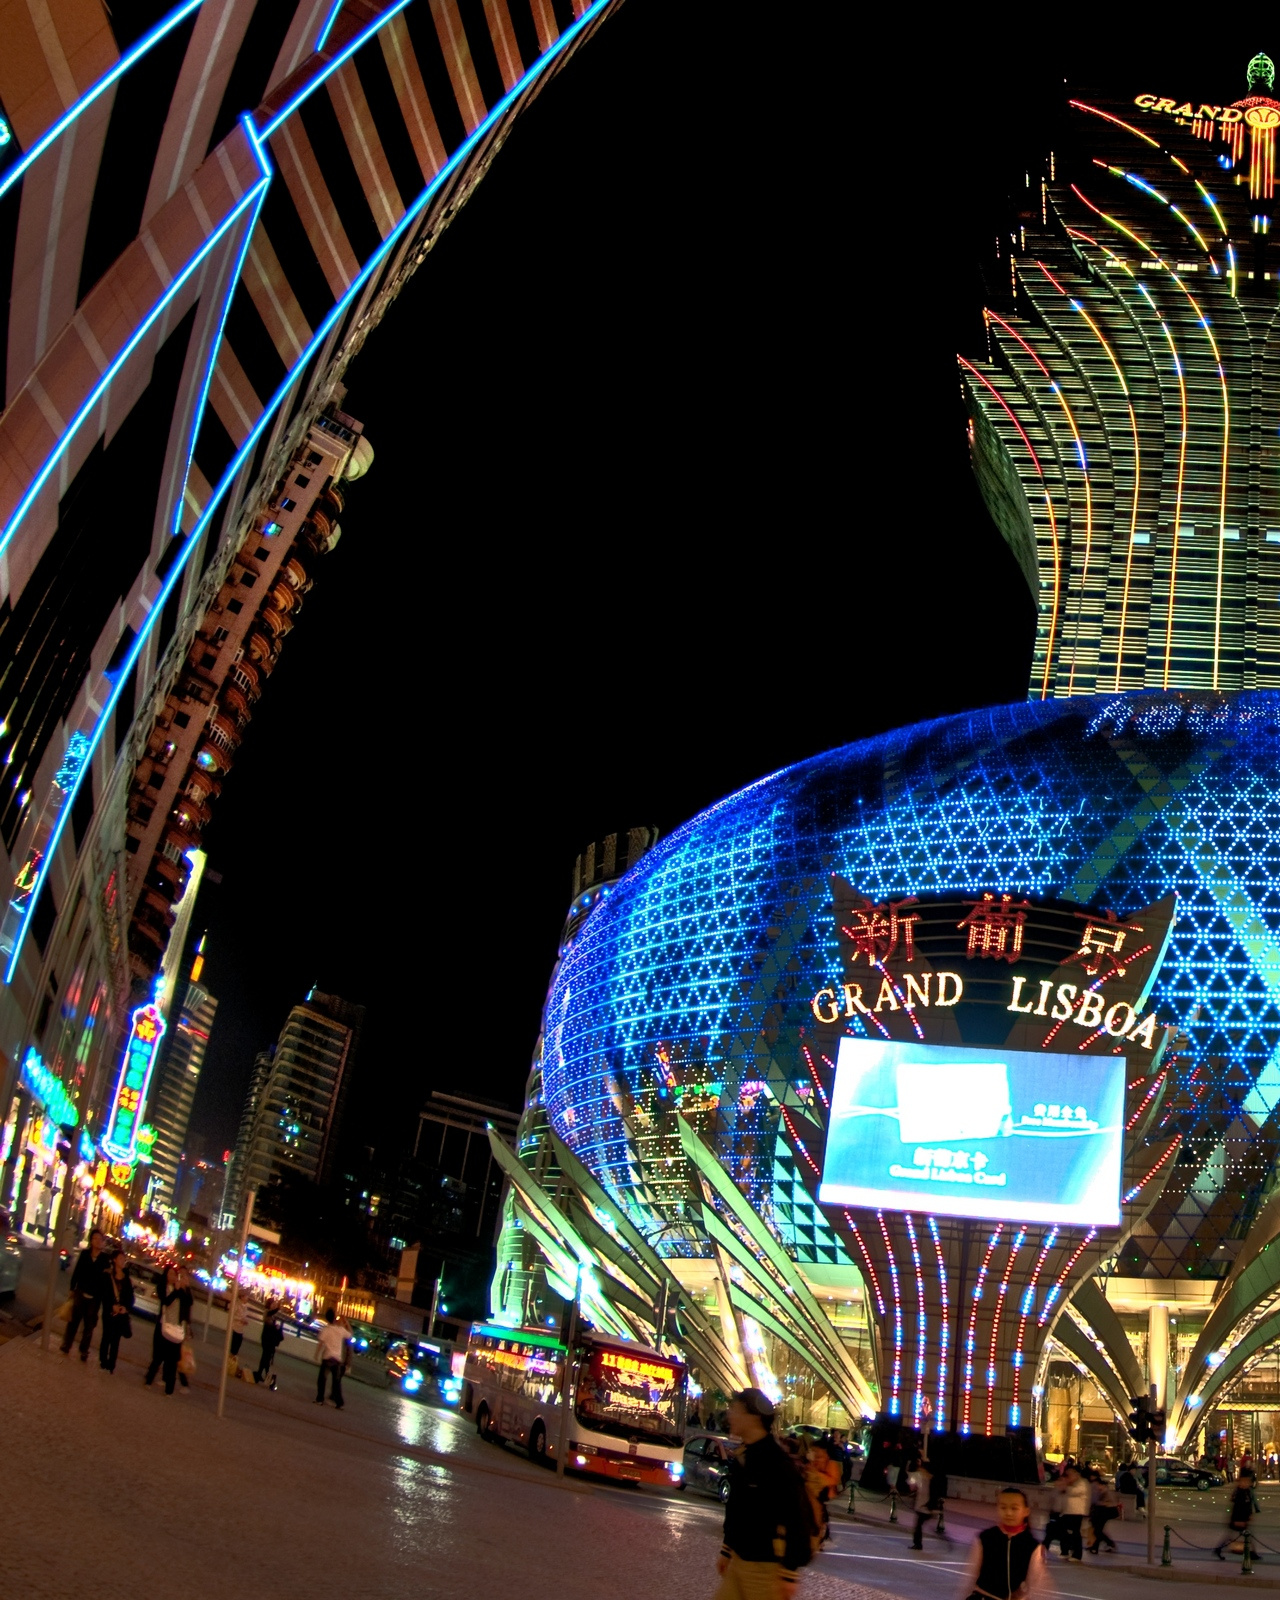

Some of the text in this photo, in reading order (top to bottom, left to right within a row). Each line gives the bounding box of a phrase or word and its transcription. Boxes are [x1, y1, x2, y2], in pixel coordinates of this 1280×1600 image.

[1134, 94, 1243, 123] GRAND
[844, 893, 1144, 976] 新葡京
[812, 972, 1162, 1049] GRAND LISBOA
[601, 1353, 617, 1367] 11
